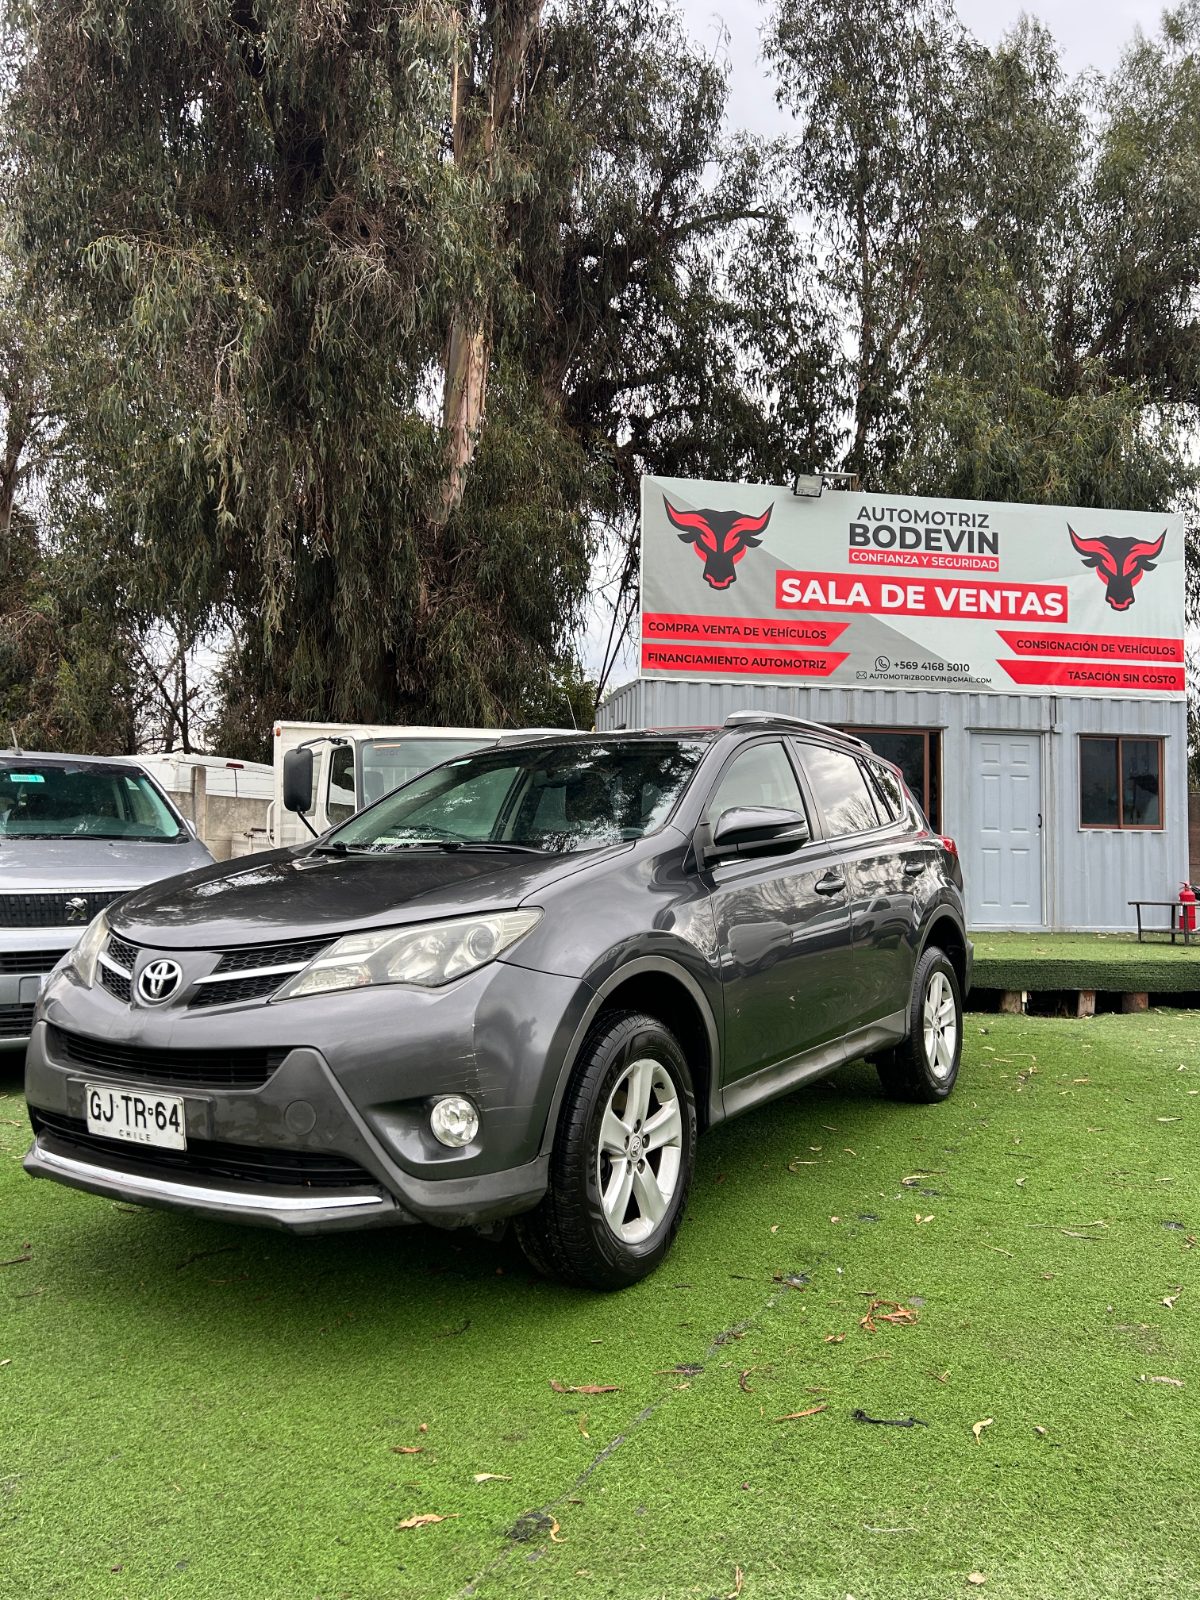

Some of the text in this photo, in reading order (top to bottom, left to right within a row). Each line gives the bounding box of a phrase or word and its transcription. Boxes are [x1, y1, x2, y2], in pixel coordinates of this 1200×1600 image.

[857, 506, 989, 528] AUTOMOTRIZ
[849, 523, 999, 554] BODEVIN
[851, 552, 997, 569] CONFIANZA Y SEGURIDAD
[781, 578, 1064, 616] SALA DE VENTAS
[648, 622, 827, 640] COMPRA VENTA DE VEHÍCULOS
[1016, 639, 1176, 656] CONSIGNACIÓN DE VEHÍCULOS
[647, 652, 827, 669] FINANCIAMIENTO AUTOMOTRIZ
[894, 661, 970, 672] +569 4168 5010
[869, 673, 992, 684] AUTOMOTRIZBODEVIN@GMAIL.COM
[1068, 670, 1177, 684] TASACIÓN SIN COSTO
[119, 1129, 151, 1141] CHILE
